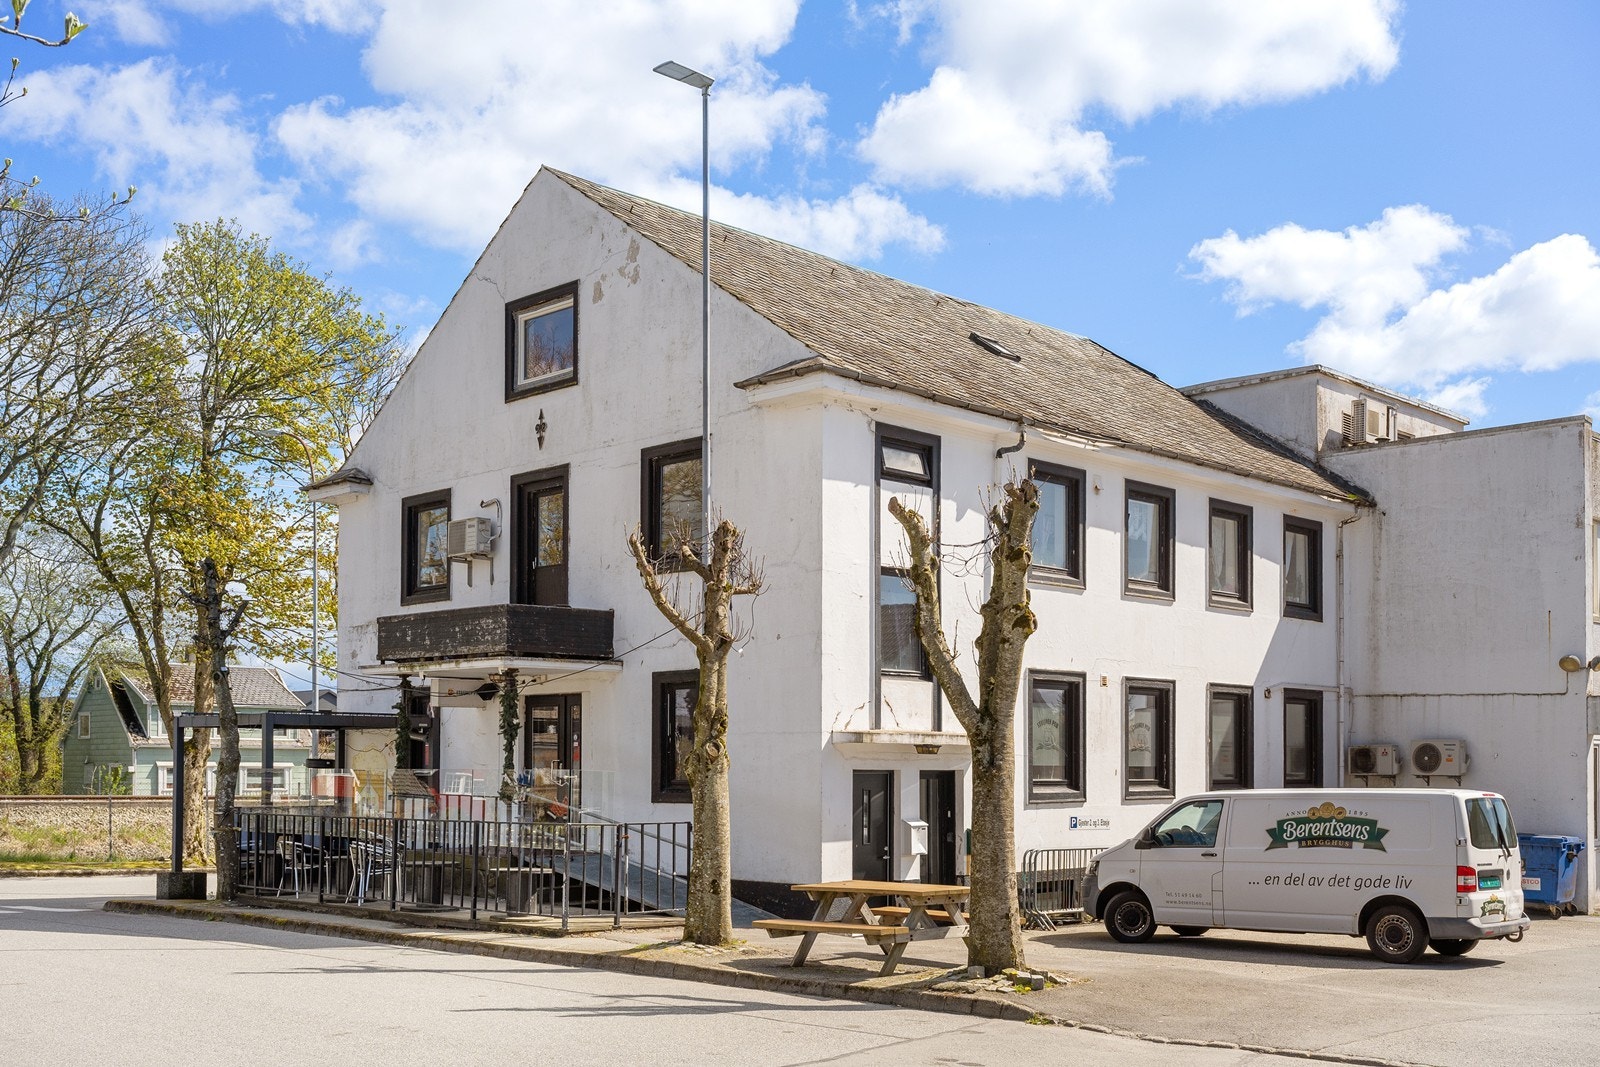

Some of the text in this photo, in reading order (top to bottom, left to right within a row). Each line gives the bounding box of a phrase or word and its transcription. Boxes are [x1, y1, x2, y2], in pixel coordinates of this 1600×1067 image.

[1283, 819, 1370, 840] Berentsens
[1301, 839, 1350, 847] BRYGGHUS
[1264, 875, 1280, 886] en
[1284, 873, 1305, 886] del
[1308, 876, 1325, 887] av
[1328, 874, 1351, 888] det
[1353, 875, 1391, 891] gode
[1395, 875, 1413, 889] liv
